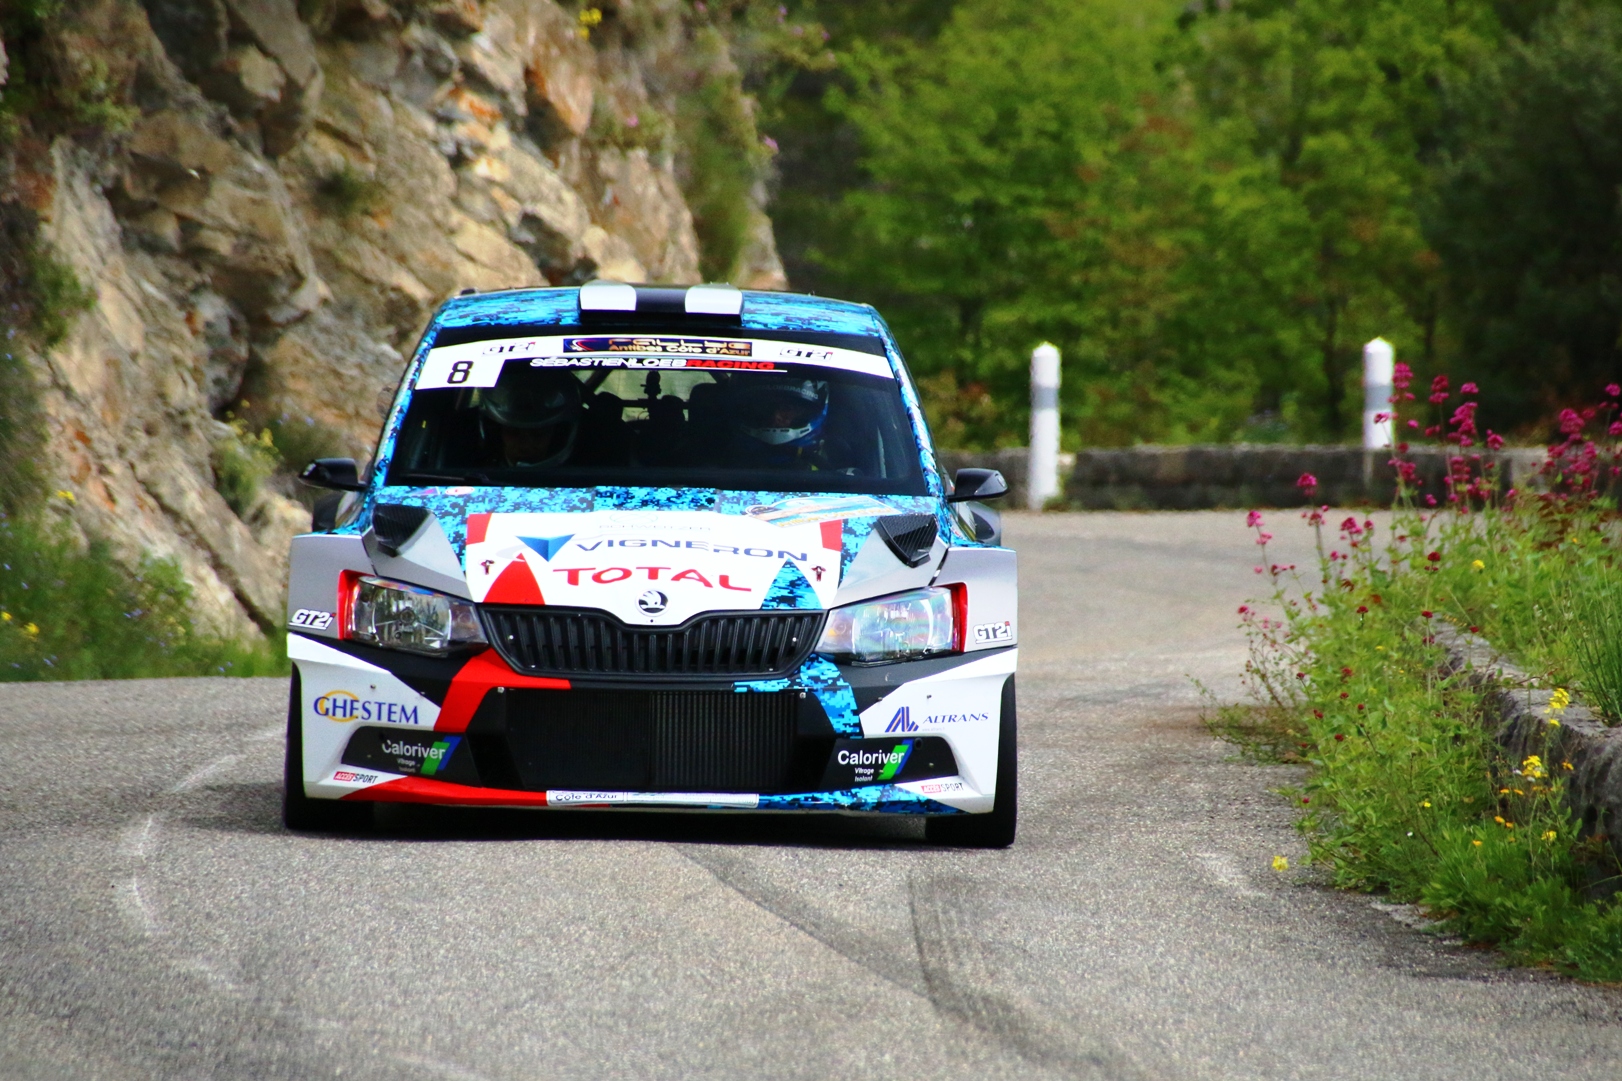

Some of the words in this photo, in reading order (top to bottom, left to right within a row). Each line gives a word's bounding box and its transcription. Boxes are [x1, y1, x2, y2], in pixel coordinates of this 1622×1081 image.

[447, 360, 474, 384] 8
[576, 539, 808, 562] VIGNERON
[553, 566, 752, 592] TOTAL
[313, 696, 420, 725] GHESTEM
[922, 711, 990, 725] ALTRANS
[381, 739, 446, 760] Caloriver
[837, 749, 905, 765] Caloriver
[941, 782, 964, 793] SPORT
